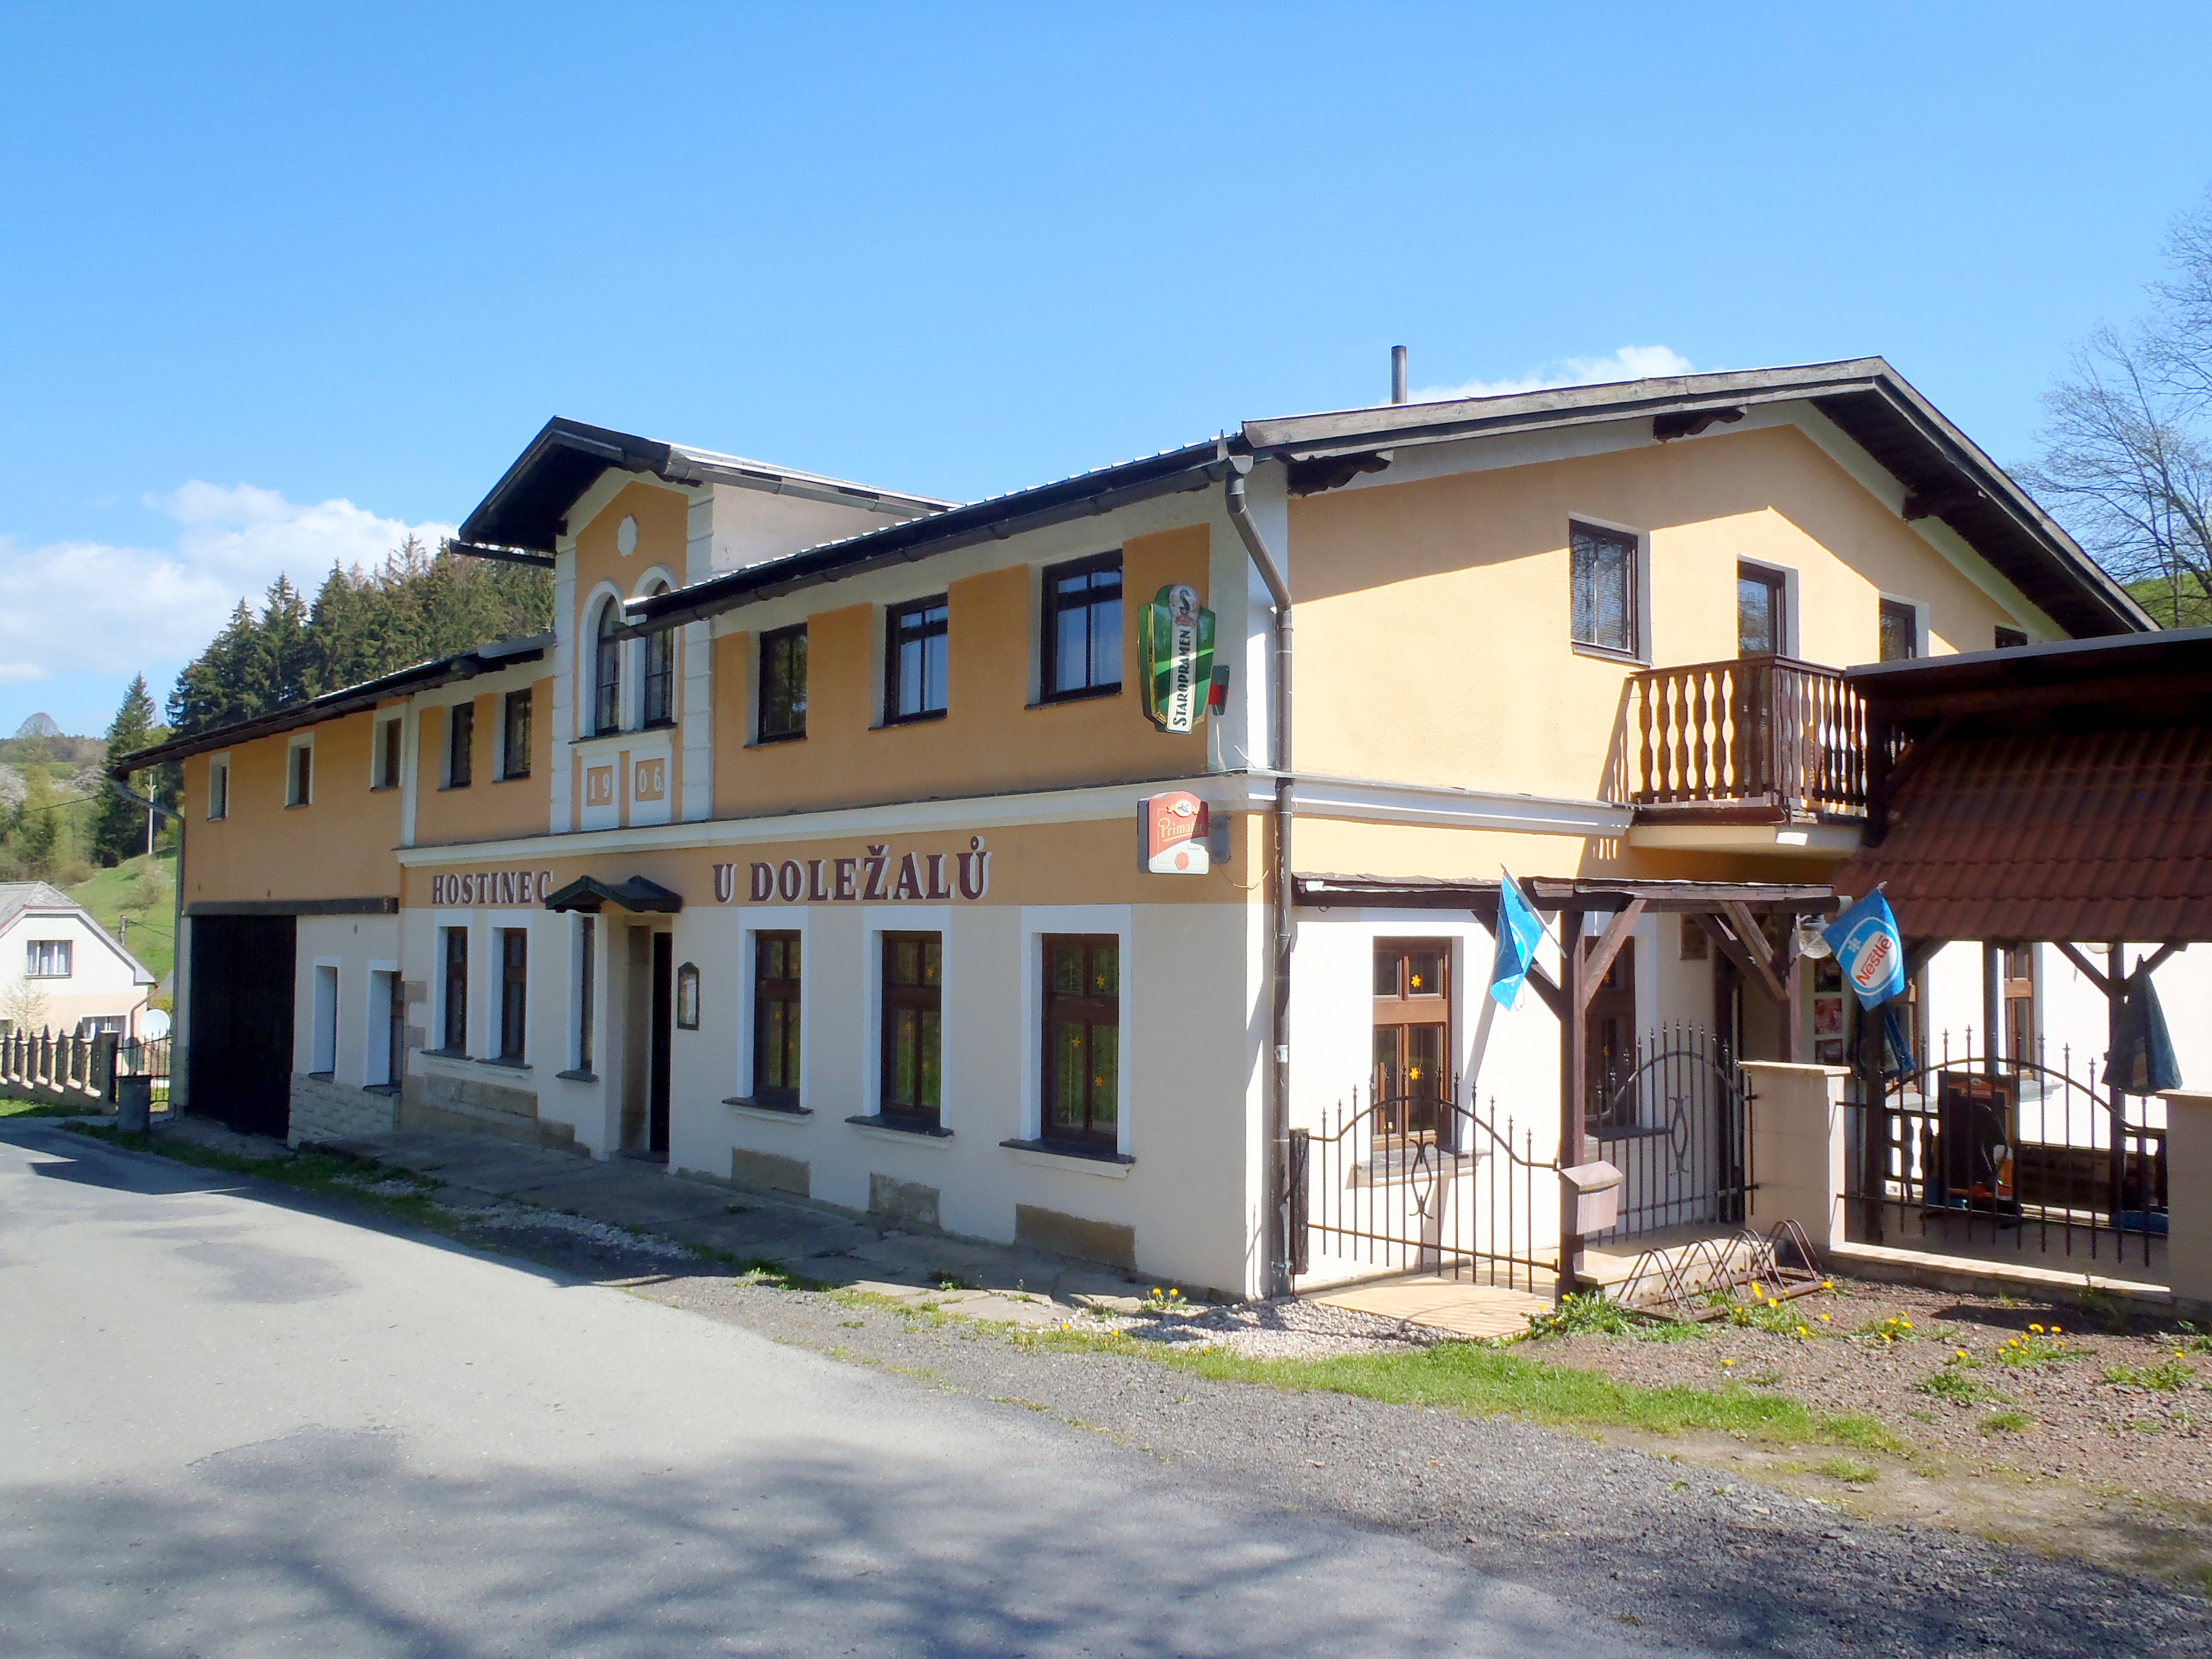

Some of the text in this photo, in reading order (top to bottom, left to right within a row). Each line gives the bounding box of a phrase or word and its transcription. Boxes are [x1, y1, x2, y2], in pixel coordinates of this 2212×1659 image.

[1173, 629, 1191, 727] STAROPRAMEN
[1157, 817, 1203, 839] Primátor
[432, 835, 993, 905] HOSTINEC U DOLEŽALŮ
[1855, 935, 1893, 987] Nestlé
